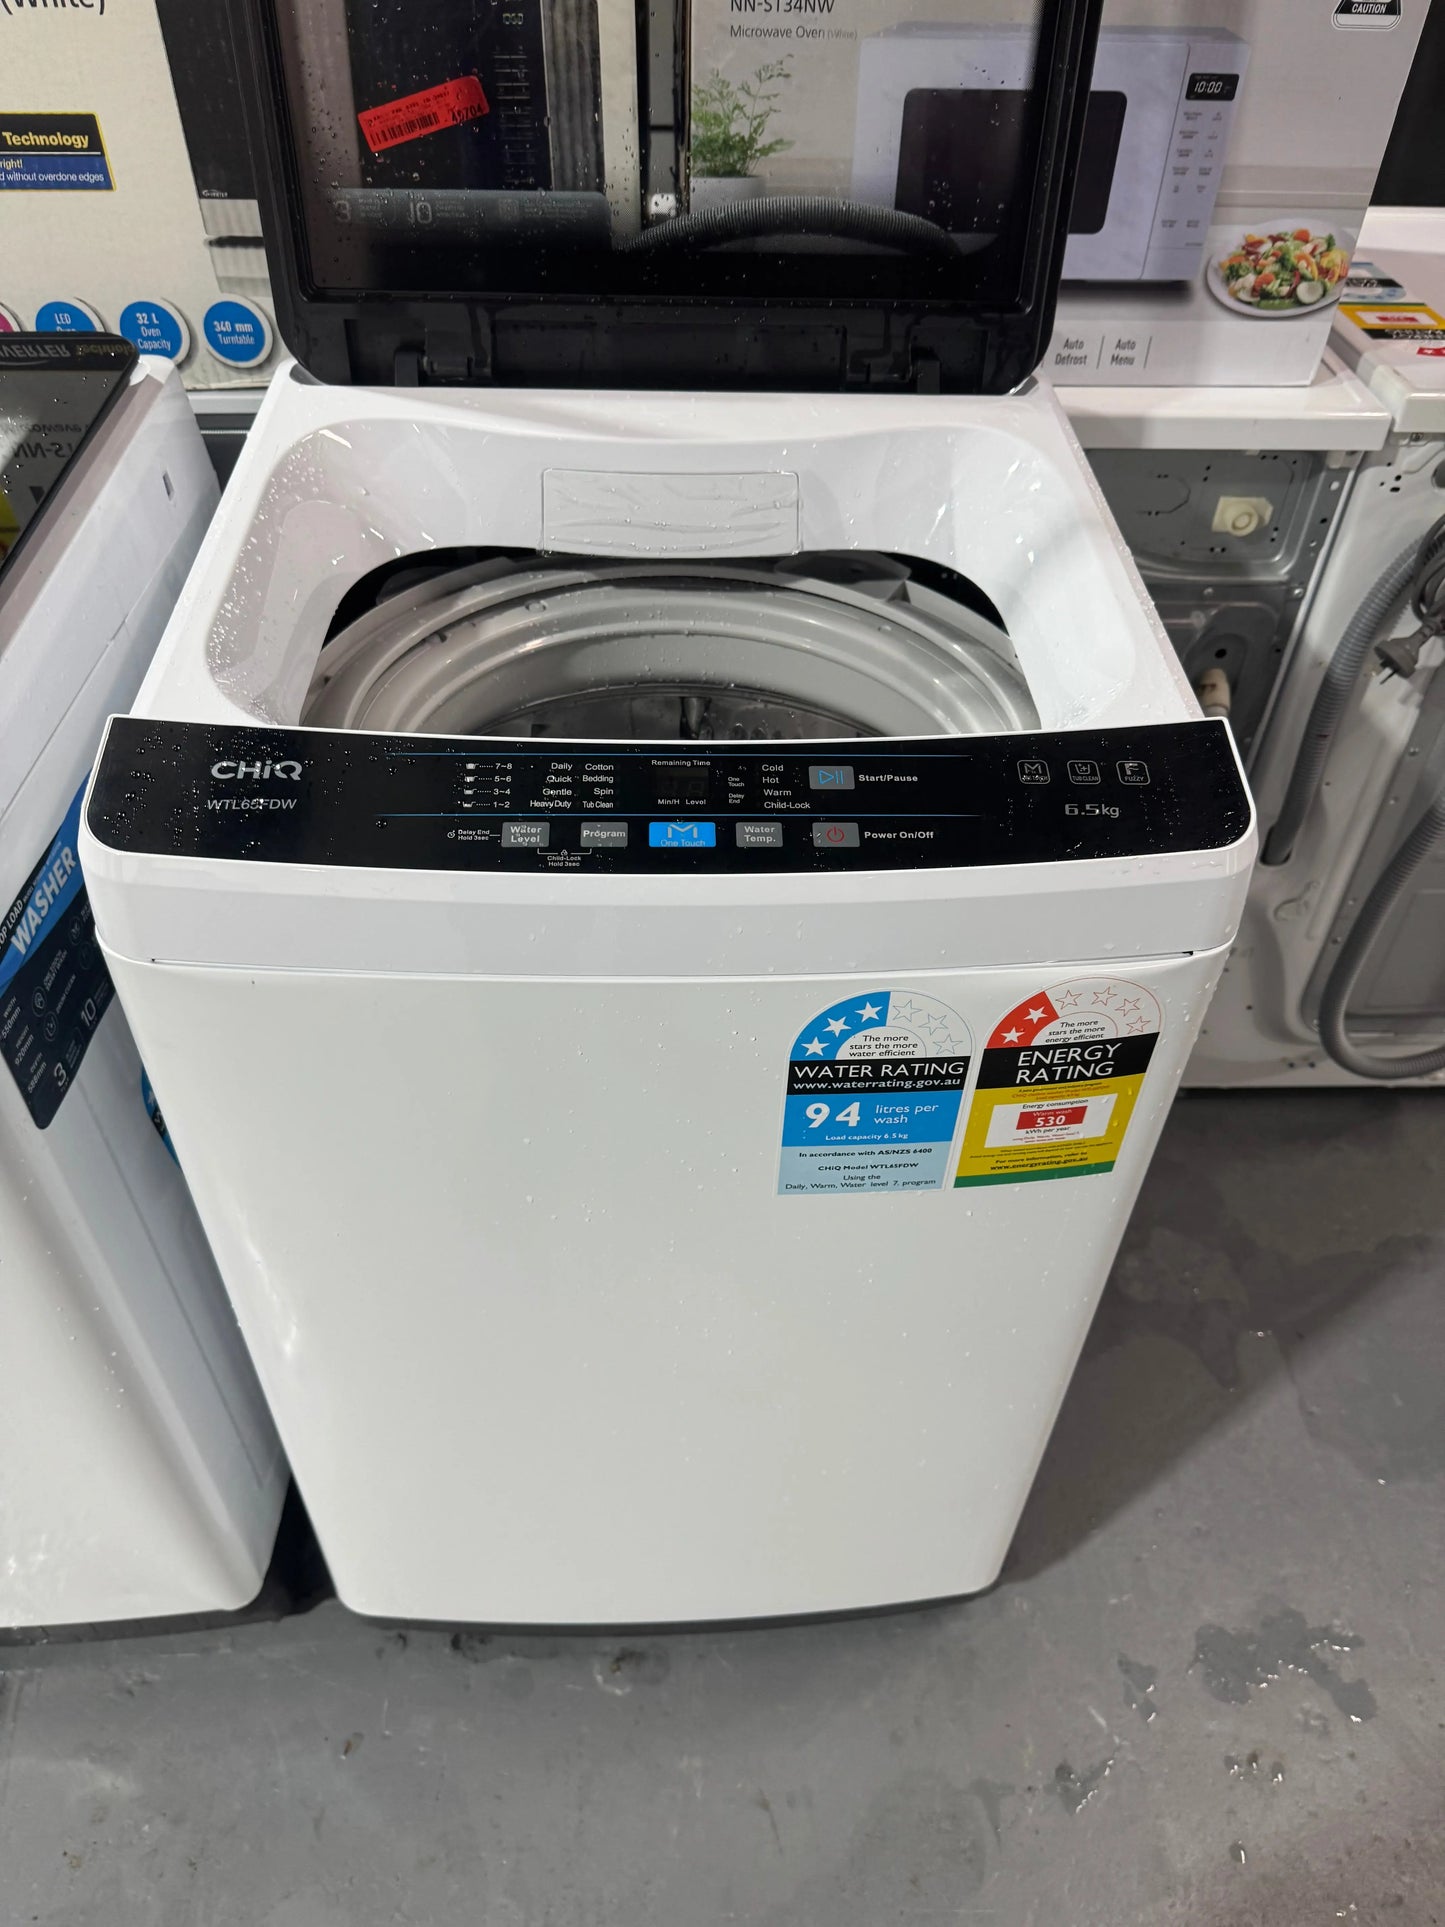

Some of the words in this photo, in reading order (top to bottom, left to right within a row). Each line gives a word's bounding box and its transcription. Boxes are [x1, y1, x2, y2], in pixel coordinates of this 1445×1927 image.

[1351, 4, 1387, 14] CAUTION
[730, 25, 792, 38] Microwave
[796, 26, 825, 38] Oven
[1194, 81, 1222, 94] 10:00
[2, 132, 89, 148] Technology
[6, 171, 37, 182] without
[38, 172, 77, 182] overdone
[78, 172, 104, 183] edges
[54, 313, 71, 324] LED
[136, 312, 149, 324] 32
[152, 313, 160, 324] L
[214, 320, 232, 332] 340
[234, 322, 254, 332] mm
[141, 327, 161, 337] Oven
[138, 339, 170, 350] Capacity
[217, 334, 256, 344] Turntable
[1064, 338, 1084, 350] Auto
[1115, 338, 1136, 350] Auto
[1055, 353, 1088, 366] Defrost
[1110, 354, 1136, 366] Menu
[211, 760, 302, 780] CHiQ
[551, 762, 573, 772] Daily
[762, 764, 784, 772] Cold
[546, 775, 572, 783] Quick
[582, 775, 614, 784] Bedding
[762, 776, 780, 784] Hot
[858, 774, 918, 782] Start/Pause
[542, 788, 572, 796] Gentle
[594, 788, 614, 796] Spin
[764, 788, 792, 796] Warm
[207, 798, 298, 810] WTL65FDW
[530, 800, 554, 808] Heavy
[554, 800, 572, 808] Duty
[764, 801, 810, 809] Child-Lock
[510, 826, 542, 834] Water
[583, 830, 626, 839] Program
[900, 831, 934, 839] On/Off
[511, 835, 540, 844] Level
[680, 839, 706, 847] Touch
[744, 834, 776, 843] Temp.
[11, 847, 77, 955] WASHER
[7, 899, 24, 930] LOAD
[3, 996, 17, 1018] WIDTH
[81, 998, 97, 1028] 10
[1, 1006, 21, 1039] 550mm
[1045, 1036, 1072, 1044] energy
[14, 1034, 35, 1066] 920mm
[1018, 1042, 1122, 1066] ENERGY
[54, 1062, 67, 1087] 3
[794, 1065, 873, 1078] WATER
[881, 1062, 965, 1077] RATING
[1016, 1062, 1115, 1084] RATING
[28, 1061, 47, 1094] 588mm
[794, 1078, 961, 1090] www.waterrating.gov.au
[876, 1104, 910, 1114] litres
[914, 1104, 939, 1115] per
[1022, 1102, 1045, 1110] Energy
[1046, 1099, 1088, 1108] consumption
[806, 1102, 860, 1128] 94
[874, 1116, 908, 1124] wash
[1036, 1115, 1066, 1126] 530
[898, 1132, 908, 1140] kg
[870, 1162, 919, 1170] WTL65FDW
[843, 1174, 866, 1182] Using
[814, 1182, 838, 1190] Warm,
